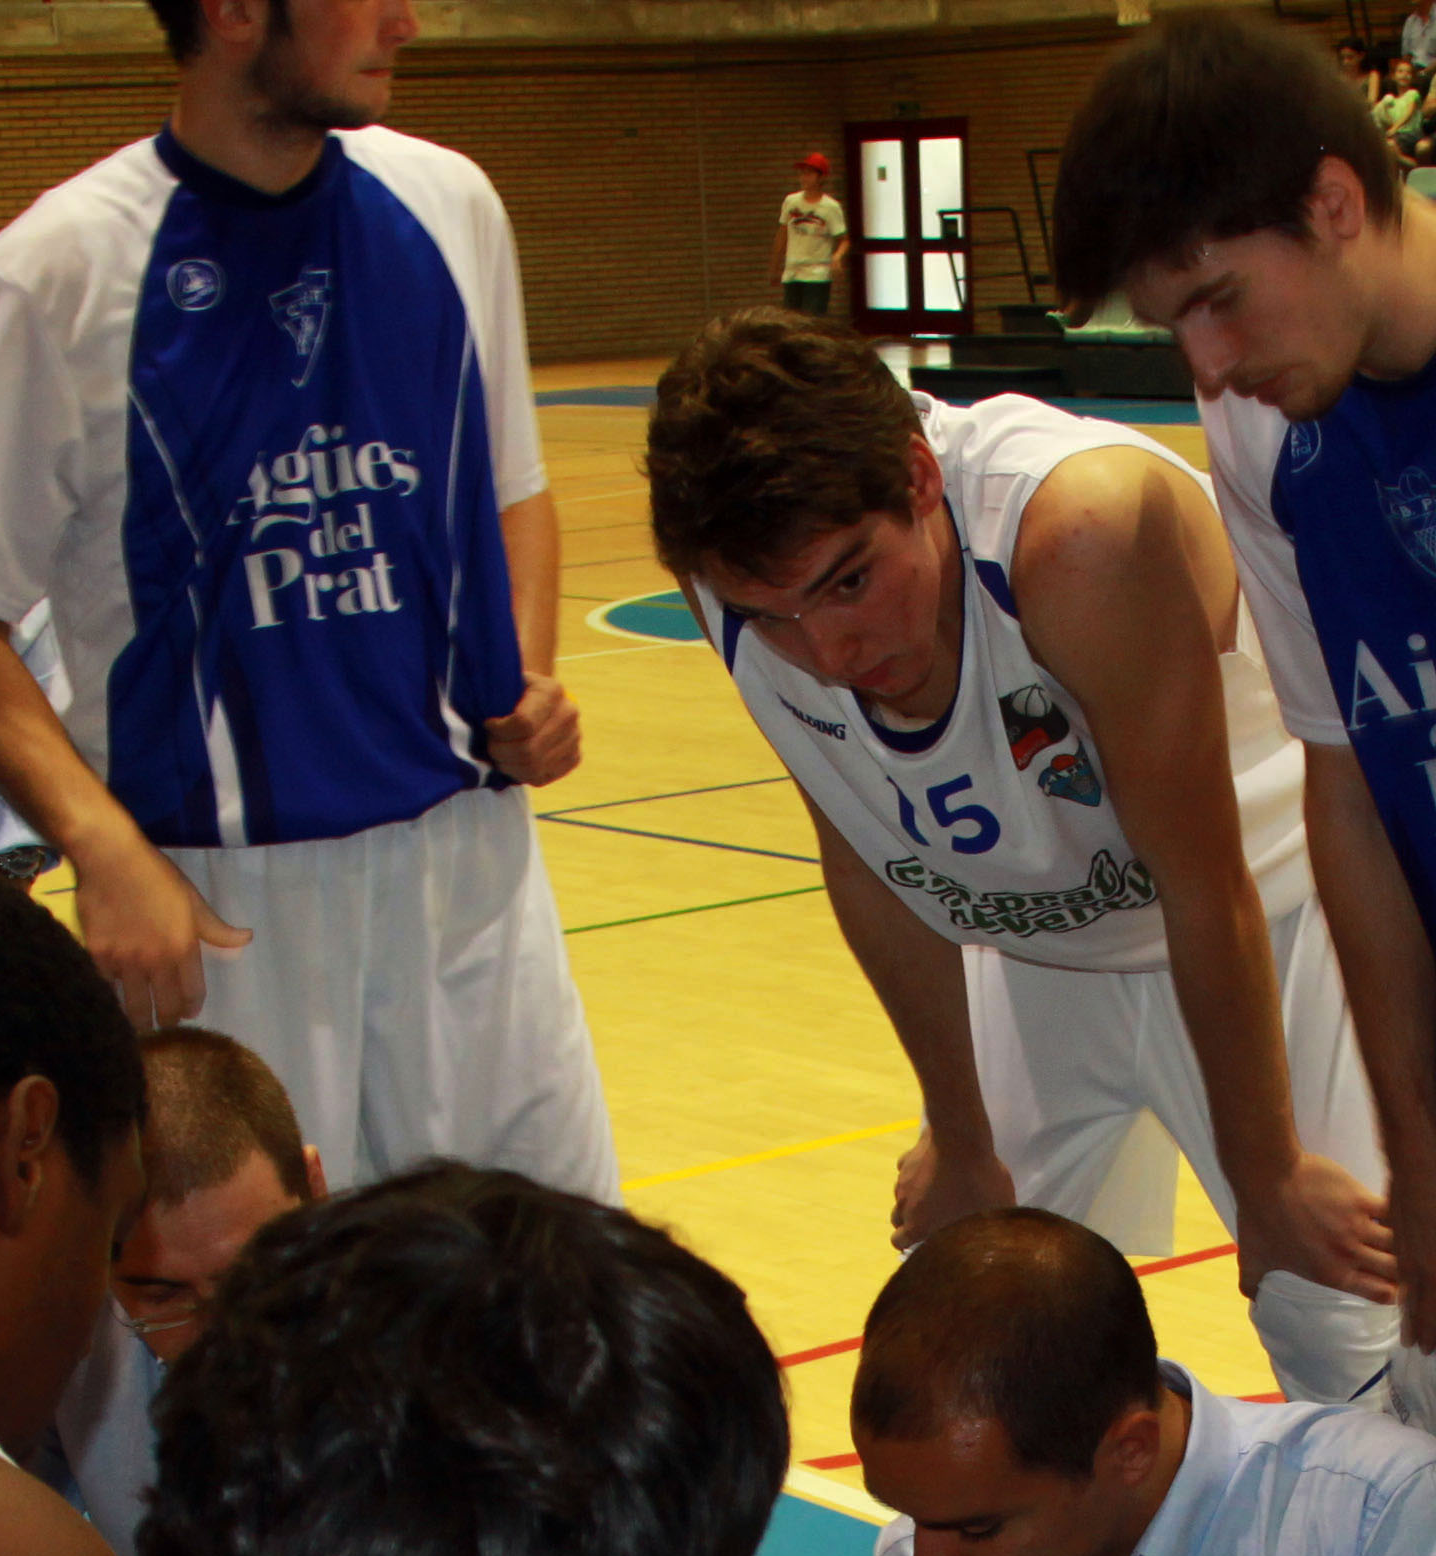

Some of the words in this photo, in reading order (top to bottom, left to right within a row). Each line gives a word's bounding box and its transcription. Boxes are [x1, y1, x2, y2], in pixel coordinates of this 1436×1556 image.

[308, 502, 376, 559] del
[242, 547, 403, 631] Prat
[885, 773, 1002, 855] 15
